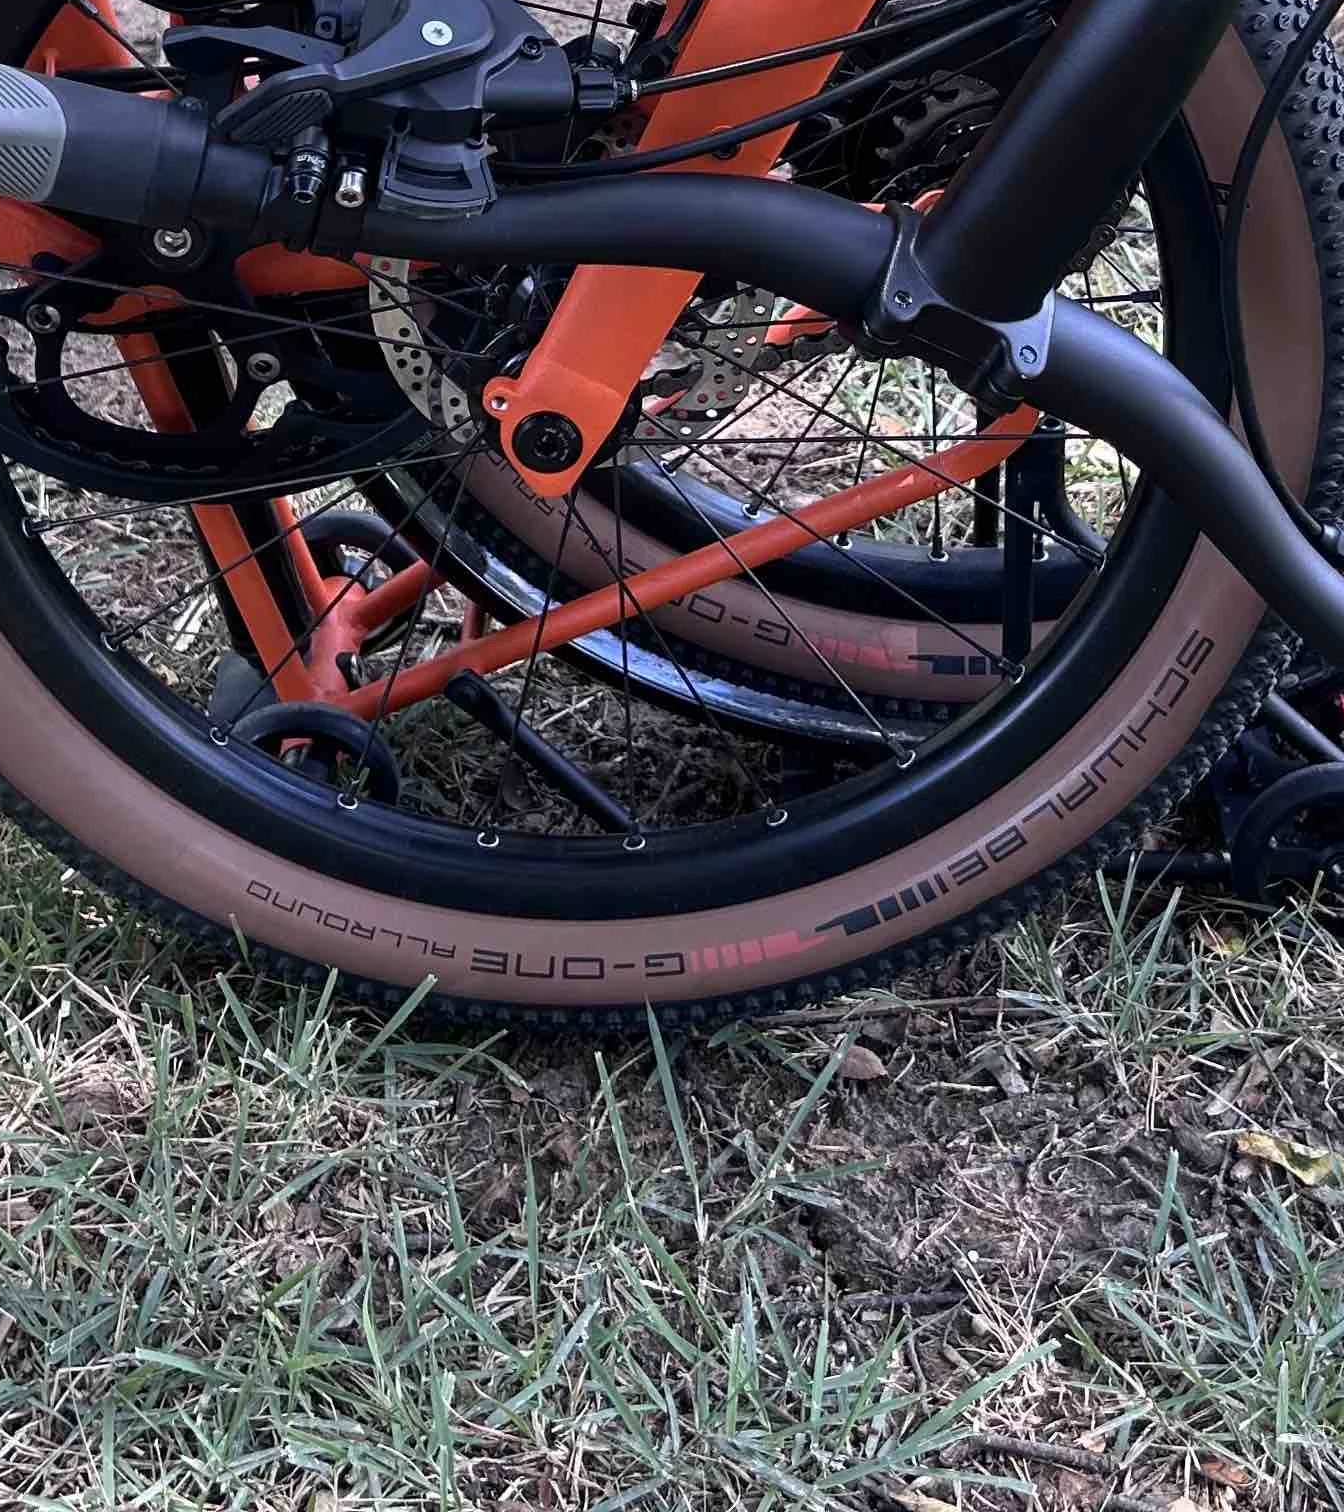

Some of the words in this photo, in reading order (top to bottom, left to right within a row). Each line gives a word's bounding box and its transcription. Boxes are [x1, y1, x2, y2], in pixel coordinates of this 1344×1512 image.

[949, 628, 1215, 887] SCHWALBE
[245, 878, 457, 960] ALLROUND
[470, 947, 686, 981] G-ONE
